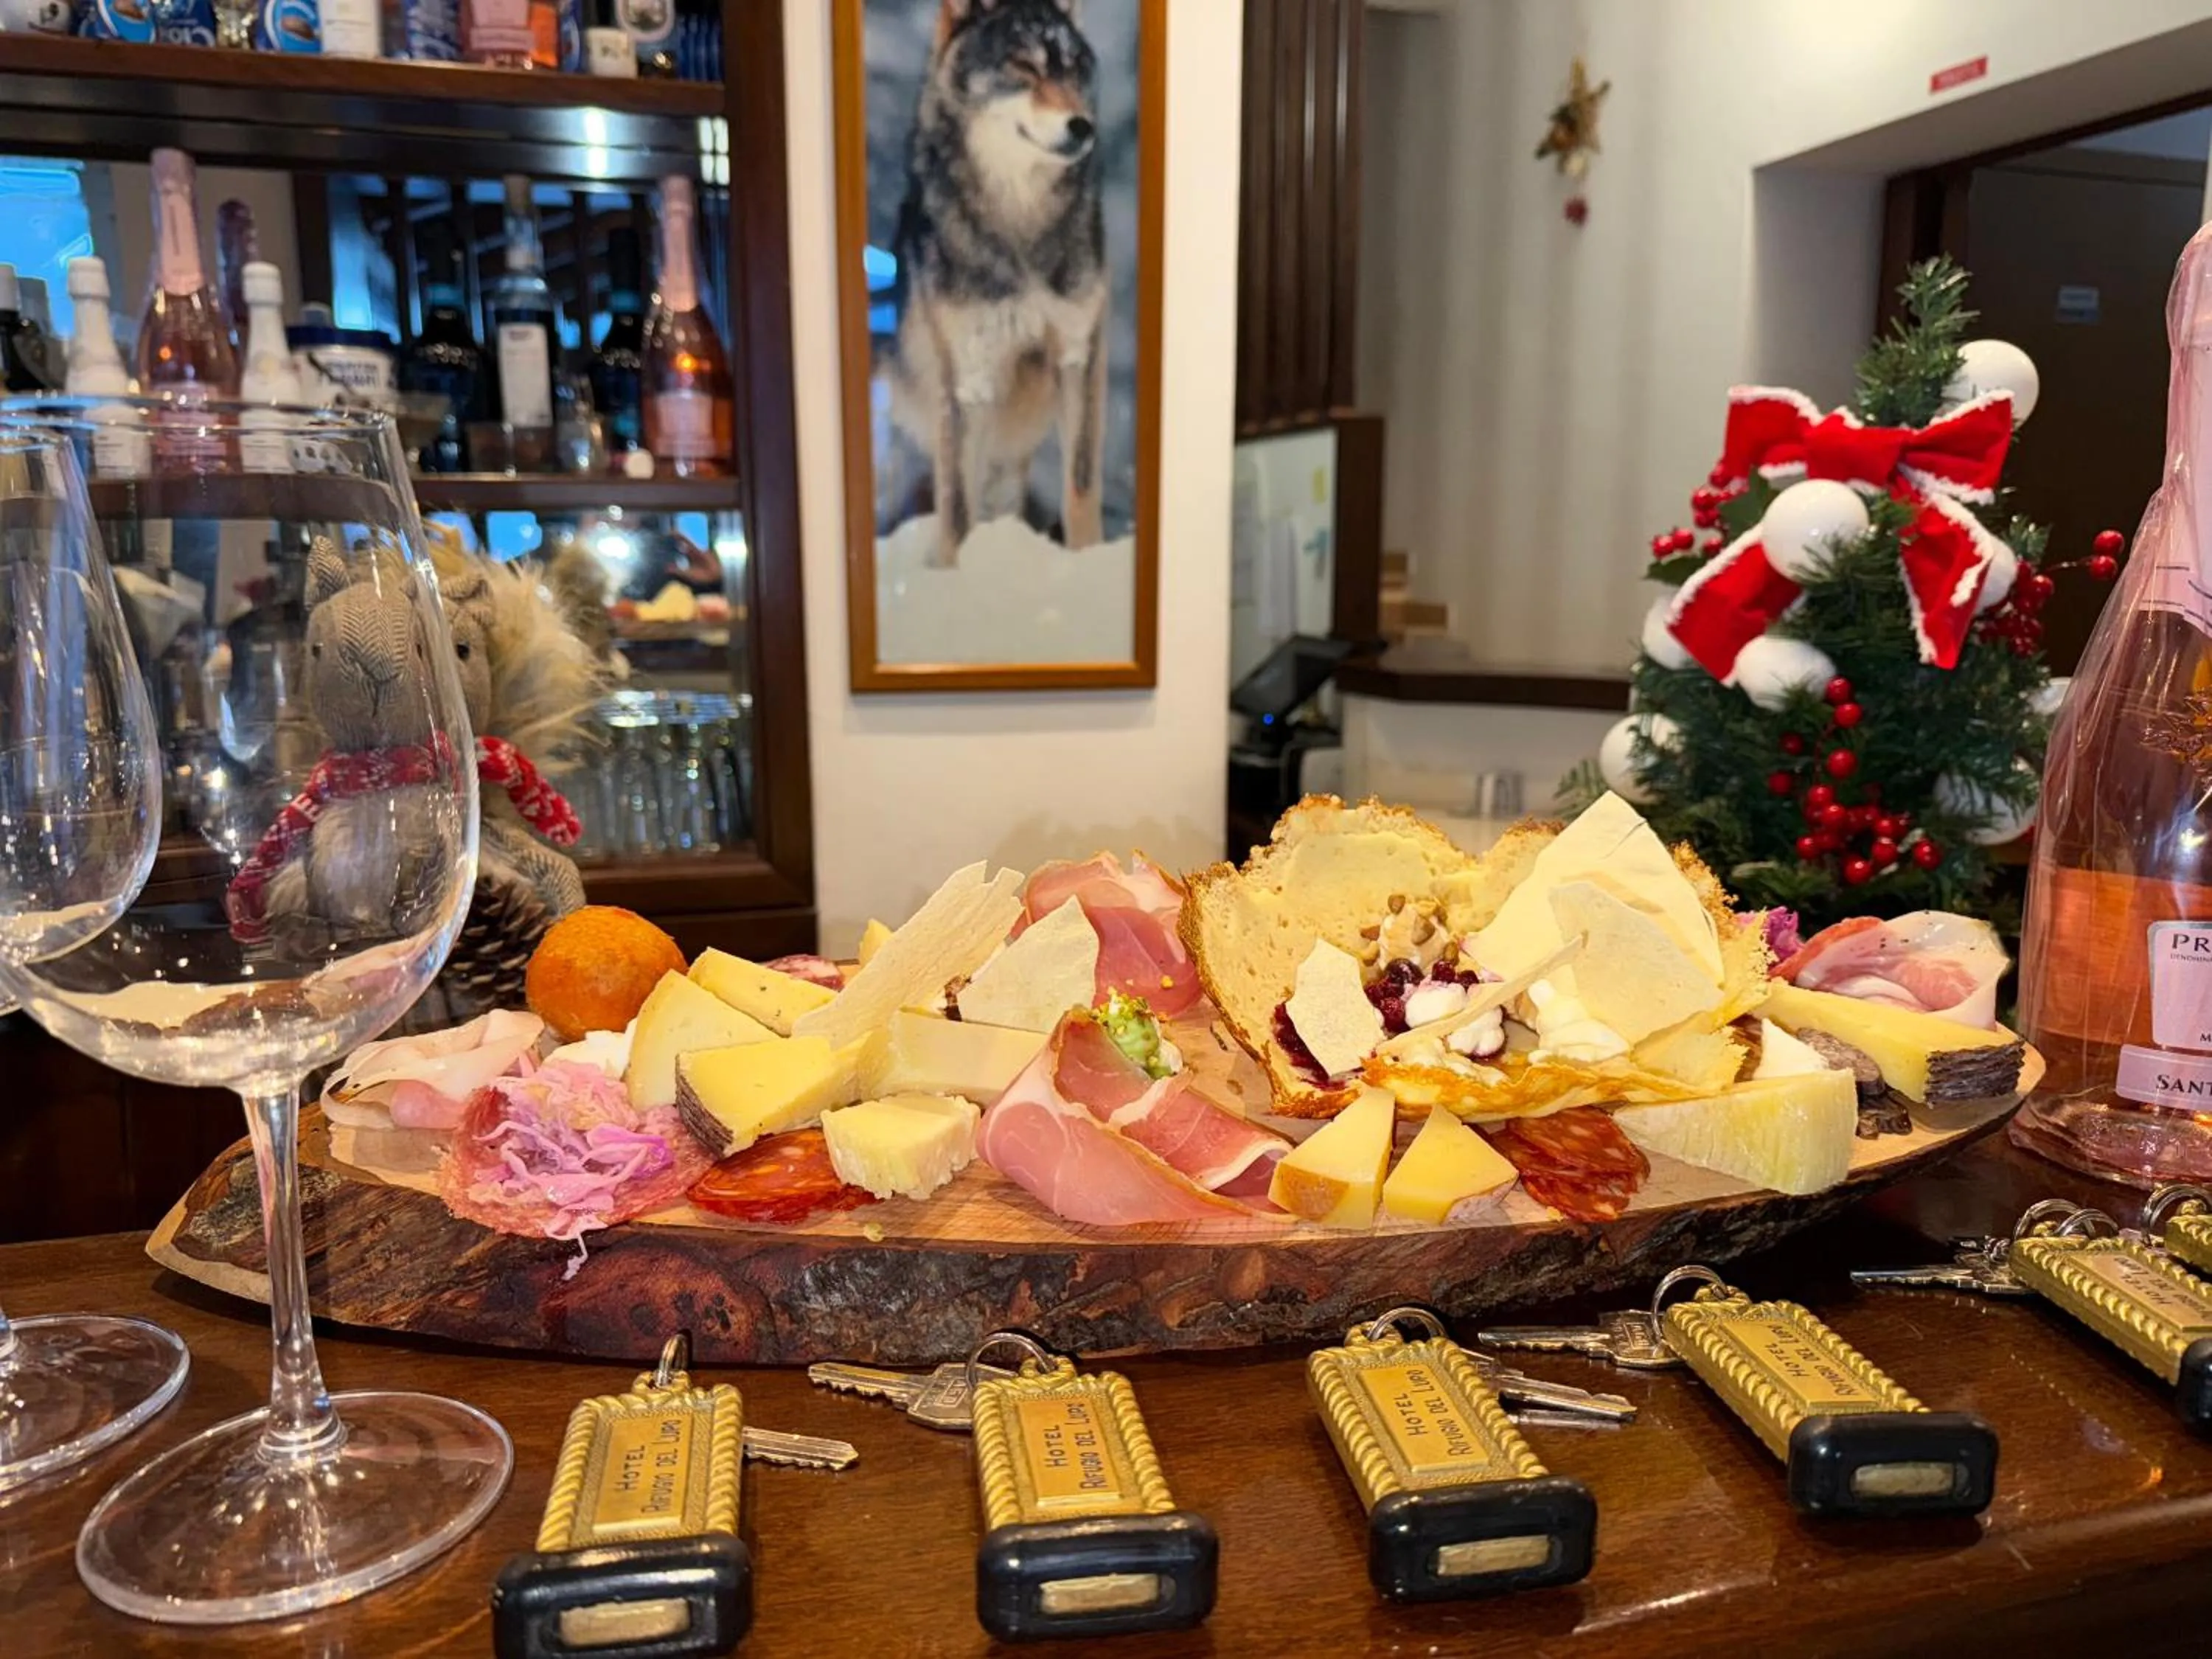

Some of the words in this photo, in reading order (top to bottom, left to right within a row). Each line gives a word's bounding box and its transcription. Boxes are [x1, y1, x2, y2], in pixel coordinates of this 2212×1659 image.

[2171, 933, 2211, 953] PR
[1394, 1393, 1428, 1436] HOTEL
[1043, 1425, 1069, 1467] HOTEL
[613, 1444, 645, 1491] HOTEL
